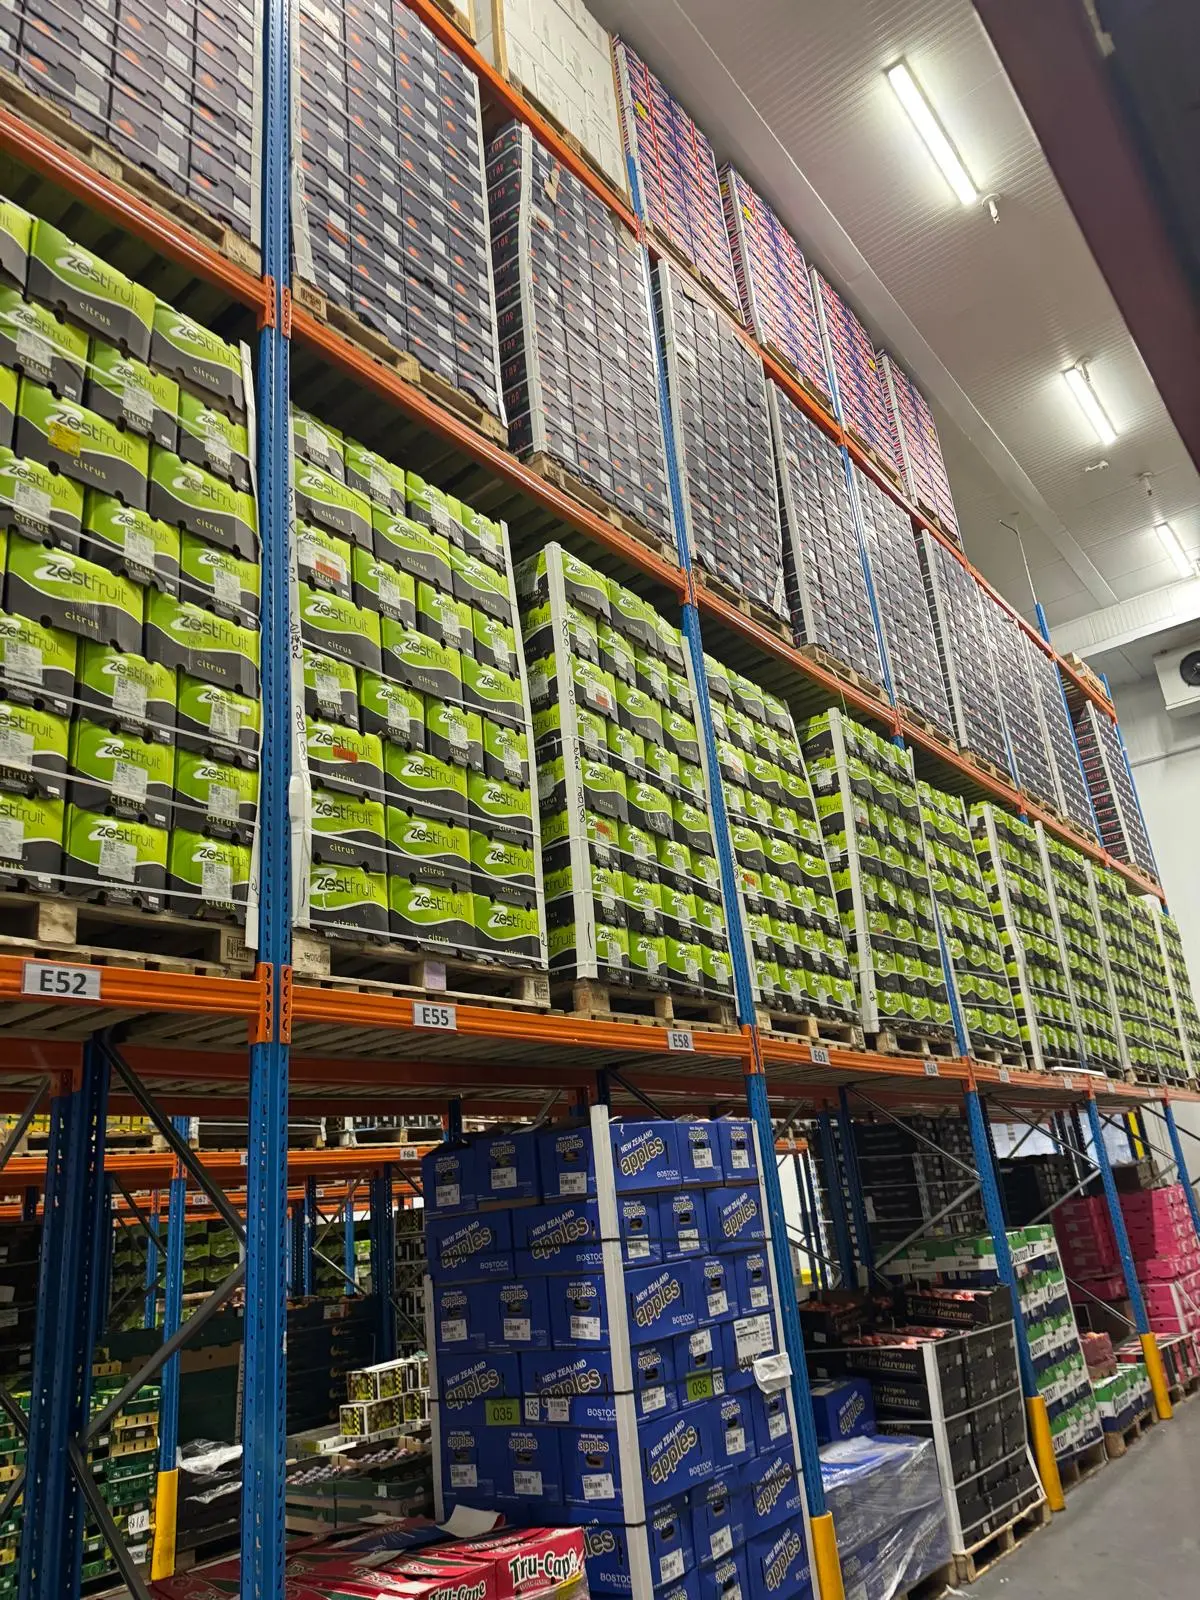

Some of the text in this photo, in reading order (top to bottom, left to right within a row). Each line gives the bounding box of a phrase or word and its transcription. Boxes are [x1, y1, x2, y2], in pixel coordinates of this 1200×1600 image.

[67, 256, 140, 311] zestfruit
[79, 300, 111, 325] citrus
[56, 410, 134, 459] zestfruit
[46, 561, 128, 606] zestfruit
[64, 610, 99, 629] citrus
[313, 602, 368, 631] zestfruit
[180, 614, 249, 649] zestfruit
[327, 640, 351, 655] citrus
[405, 641, 453, 669] zestfruit
[197, 659, 227, 675] citrus
[418, 674, 439, 688] citrus
[482, 674, 521, 700] zestfruit
[0, 712, 55, 740] estfruit
[105, 743, 161, 769] zestfruit
[315, 732, 373, 758] zestfruit
[0, 767, 34, 783] itrus
[408, 763, 458, 785] zestfruit
[488, 789, 529, 811] zestfruit
[0, 803, 46, 825] stfruit
[315, 801, 374, 826] zestfruit
[97, 824, 156, 848] zestfruit
[410, 826, 461, 851] zestfruit
[329, 843, 355, 855] citrus
[490, 849, 533, 870] zestfruit
[423, 866, 445, 877] citrus
[317, 876, 377, 898] zestfruit
[415, 893, 465, 916] zestfruit
[494, 913, 538, 931] zestfruit
[428, 933, 450, 944] citrus
[39, 969, 87, 995] E52
[423, 1007, 449, 1026] E55
[673, 1034, 689, 1048] E58
[814, 1050, 826, 1062] E61
[556, 1139, 583, 1151] apples
[621, 1130, 653, 1153] NEW ZEALAND
[621, 1137, 664, 1176] apples
[623, 1206, 646, 1218] apples
[673, 1201, 693, 1213] apples
[722, 1193, 748, 1216] NEW ZEALAND
[532, 1209, 575, 1236] NEW ZEALAND
[723, 1199, 757, 1237] apples
[442, 1221, 480, 1247] NEW ZEALAND
[530, 1217, 589, 1259] apples
[440, 1227, 492, 1268] apples
[576, 1253, 603, 1262] BOSTOC
[480, 1261, 508, 1270] BOSTOCK
[704, 1264, 724, 1277] apples
[501, 1288, 528, 1301] apples
[567, 1285, 597, 1298] apples
[636, 1272, 669, 1302] NEW ZEALAND
[635, 1279, 680, 1327] apples
[938, 1308, 972, 1319] Garenne
[672, 1314, 694, 1325] BOSTOCK
[447, 1361, 486, 1386] NEW ZEALAND
[542, 1359, 587, 1383] NEW ZEALAND
[879, 1358, 916, 1370] Garenne
[445, 1369, 500, 1410] apples
[693, 1380, 708, 1394] 035
[526, 1401, 539, 1417] 135
[882, 1395, 920, 1407] Garenne
[493, 1407, 513, 1421] 035
[587, 1408, 617, 1417] BOSTOC
[448, 1436, 475, 1448] apples
[509, 1437, 538, 1450] apples
[578, 1439, 609, 1453] apples
[650, 1420, 685, 1457] NEW ZEALAND
[650, 1426, 697, 1484] apples
[689, 1461, 712, 1476] BOSTOCK
[756, 1463, 793, 1516] apples
[585, 1529, 615, 1557] les
[765, 1528, 790, 1565] NEW ZEALAND
[766, 1534, 801, 1591] apples
[600, 1573, 631, 1584] BOSTOC
